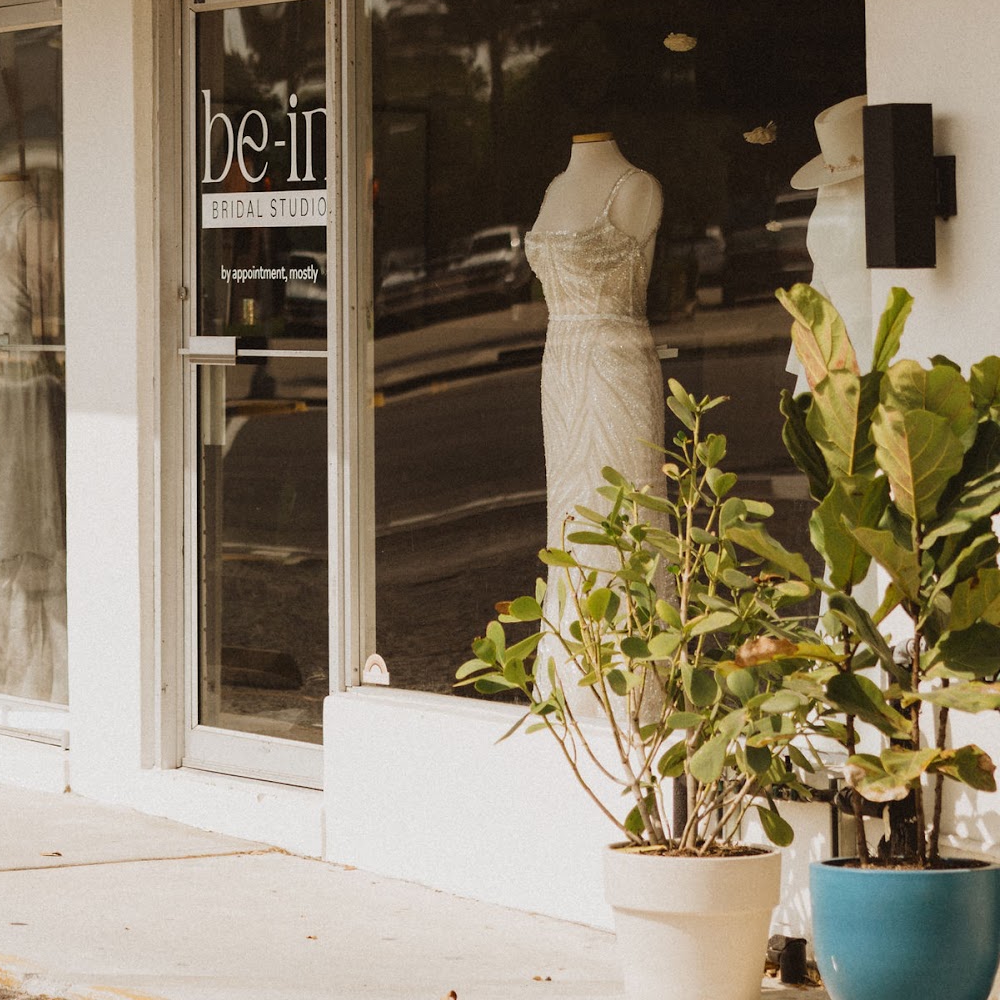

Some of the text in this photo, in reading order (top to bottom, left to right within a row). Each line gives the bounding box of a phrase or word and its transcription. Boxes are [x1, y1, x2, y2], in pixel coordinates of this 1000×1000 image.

[201, 89, 327, 183] be-in
[212, 196, 327, 219] BRIDAL STUDIO
[221, 264, 319, 284] by appointment, mostly
